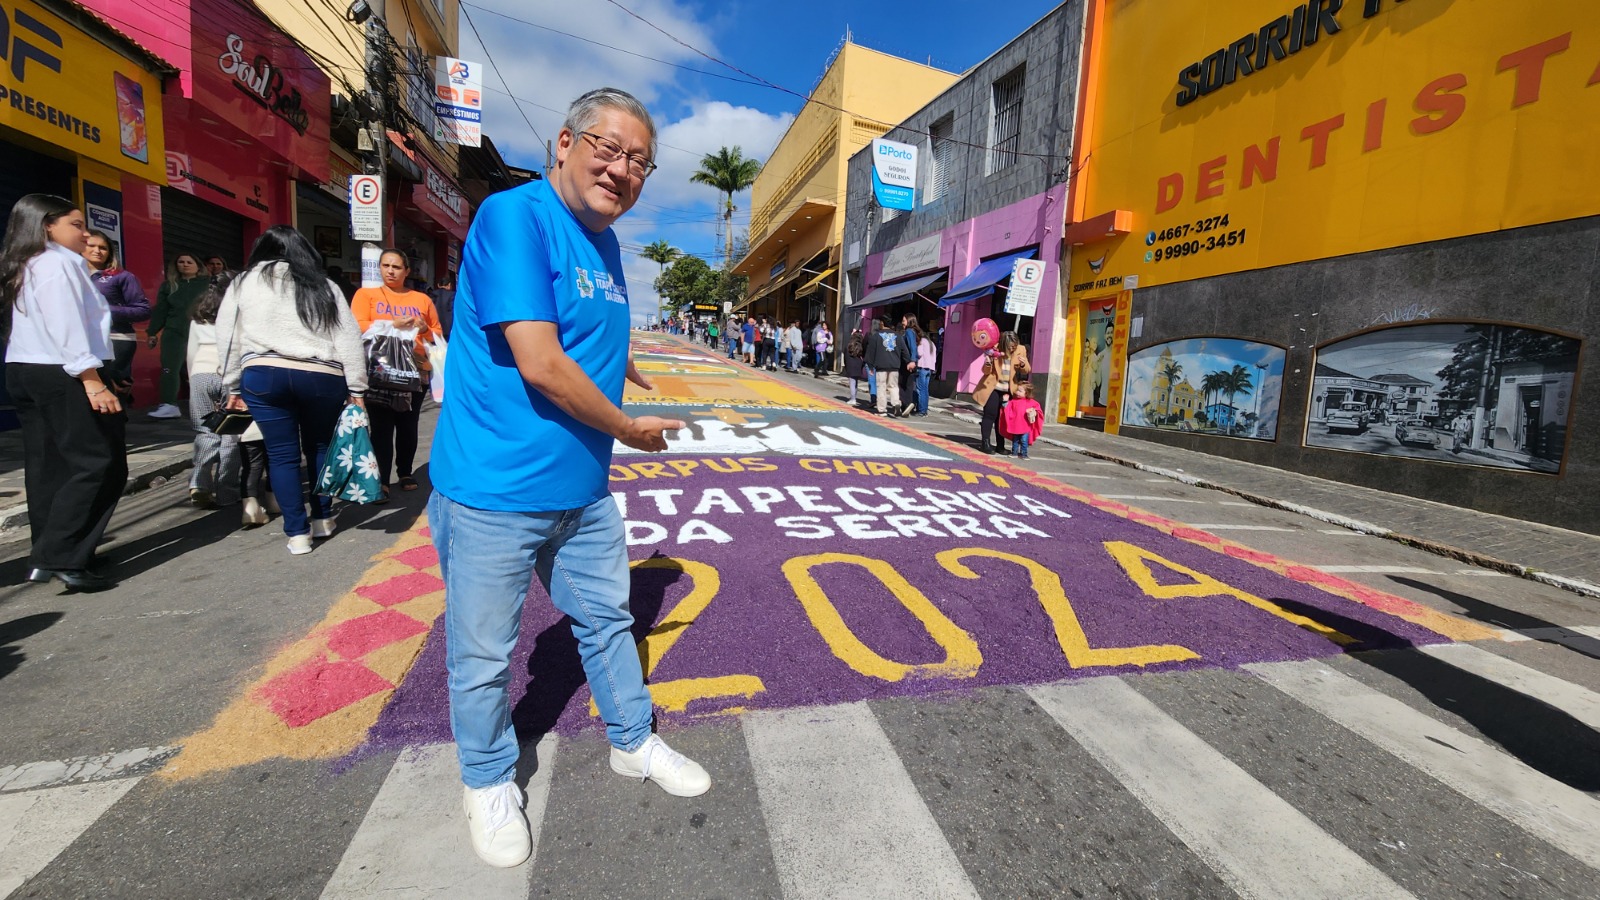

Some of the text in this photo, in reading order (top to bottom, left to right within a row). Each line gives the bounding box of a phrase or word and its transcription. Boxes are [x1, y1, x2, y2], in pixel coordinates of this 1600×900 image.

[219, 33, 270, 99] Soul
[1176, 0, 1342, 107] SORRIR
[0, 84, 101, 144] PRESENTES
[436, 106, 480, 120] EMPRÉSTIMOS
[1155, 31, 1600, 213] DENTIST
[888, 146, 913, 160] Porto
[363, 184, 371, 198] E
[883, 171, 911, 182] SEGUROS
[1157, 213, 1229, 242] 4667-3274
[1154, 228, 1246, 262] 9 9990-3451
[1025, 267, 1034, 280] E
[1073, 276, 1123, 293] SORRIR FAZ BEM
[376, 302, 421, 317] CALVIN
[608, 457, 1010, 490] ORPUS CHRISTI
[615, 485, 1073, 520] ITAPECERICA
[624, 514, 1054, 546] DA SERRA
[589, 541, 1362, 715] 2024
